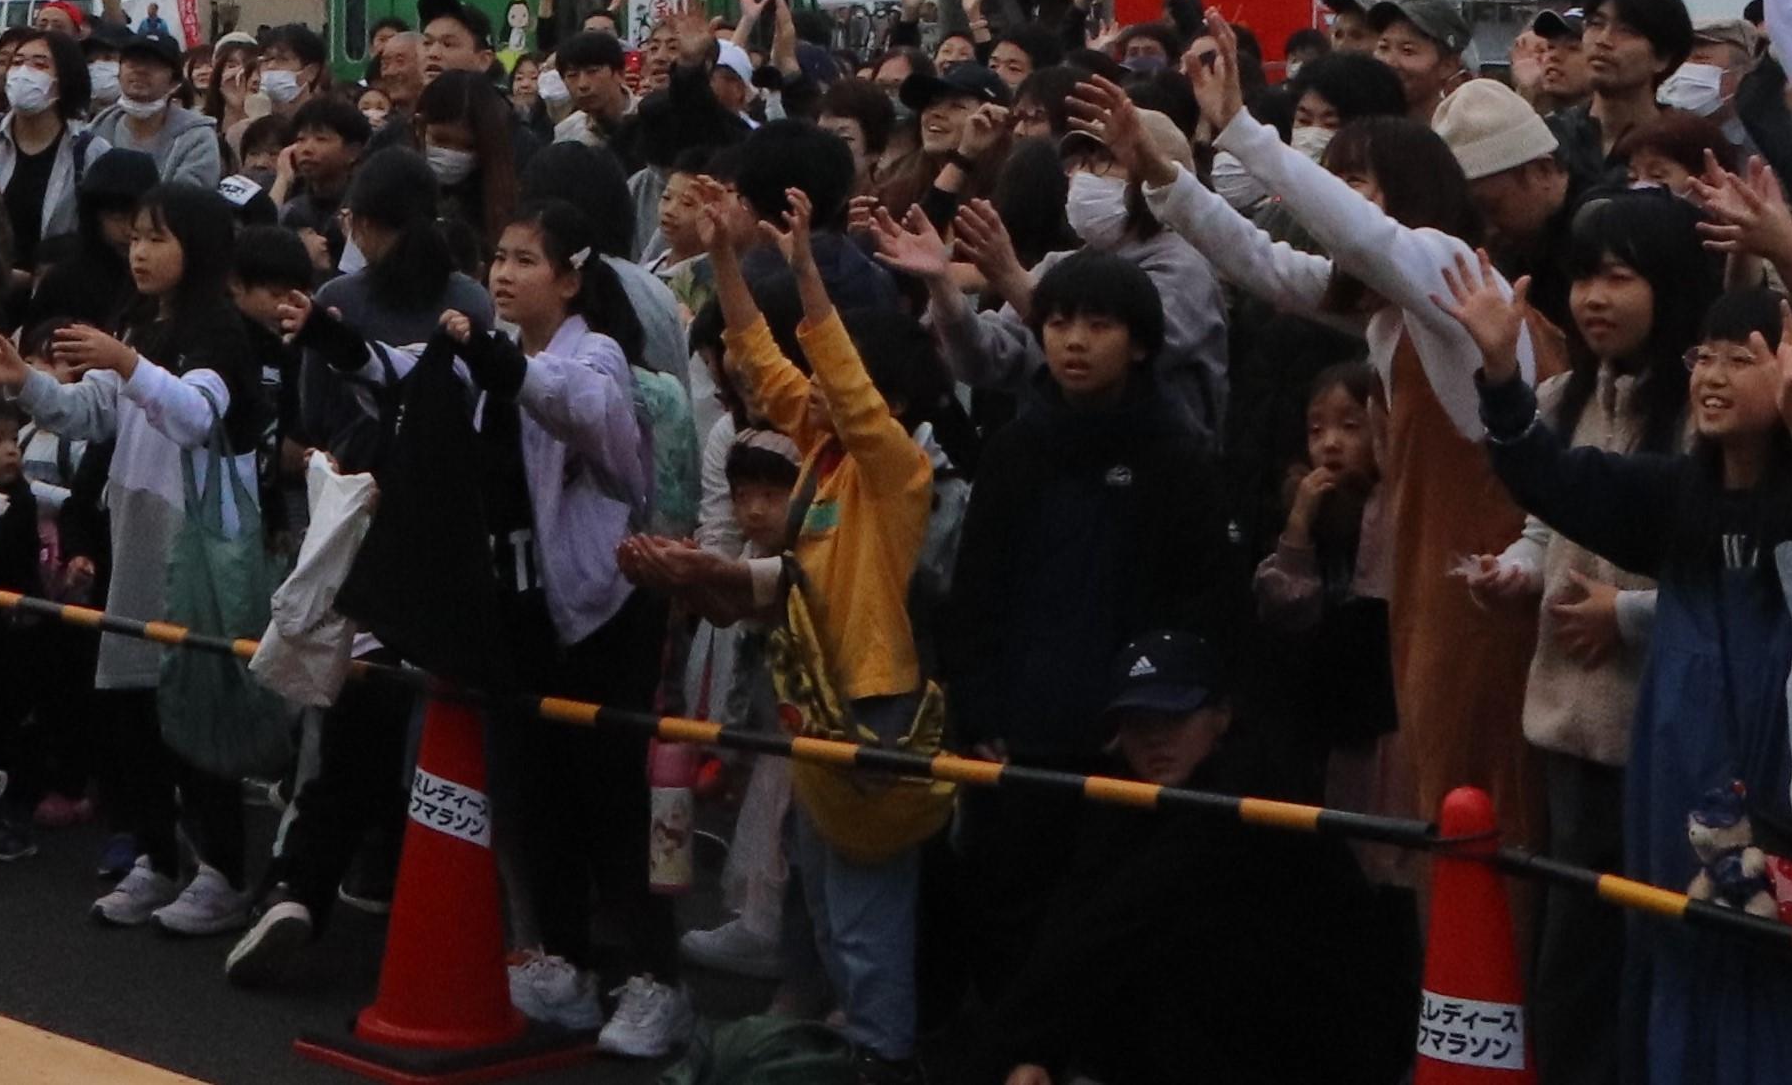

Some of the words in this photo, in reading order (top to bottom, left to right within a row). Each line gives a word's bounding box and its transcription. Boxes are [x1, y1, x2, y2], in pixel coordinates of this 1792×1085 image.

[1420, 995, 1519, 1033] レディース
